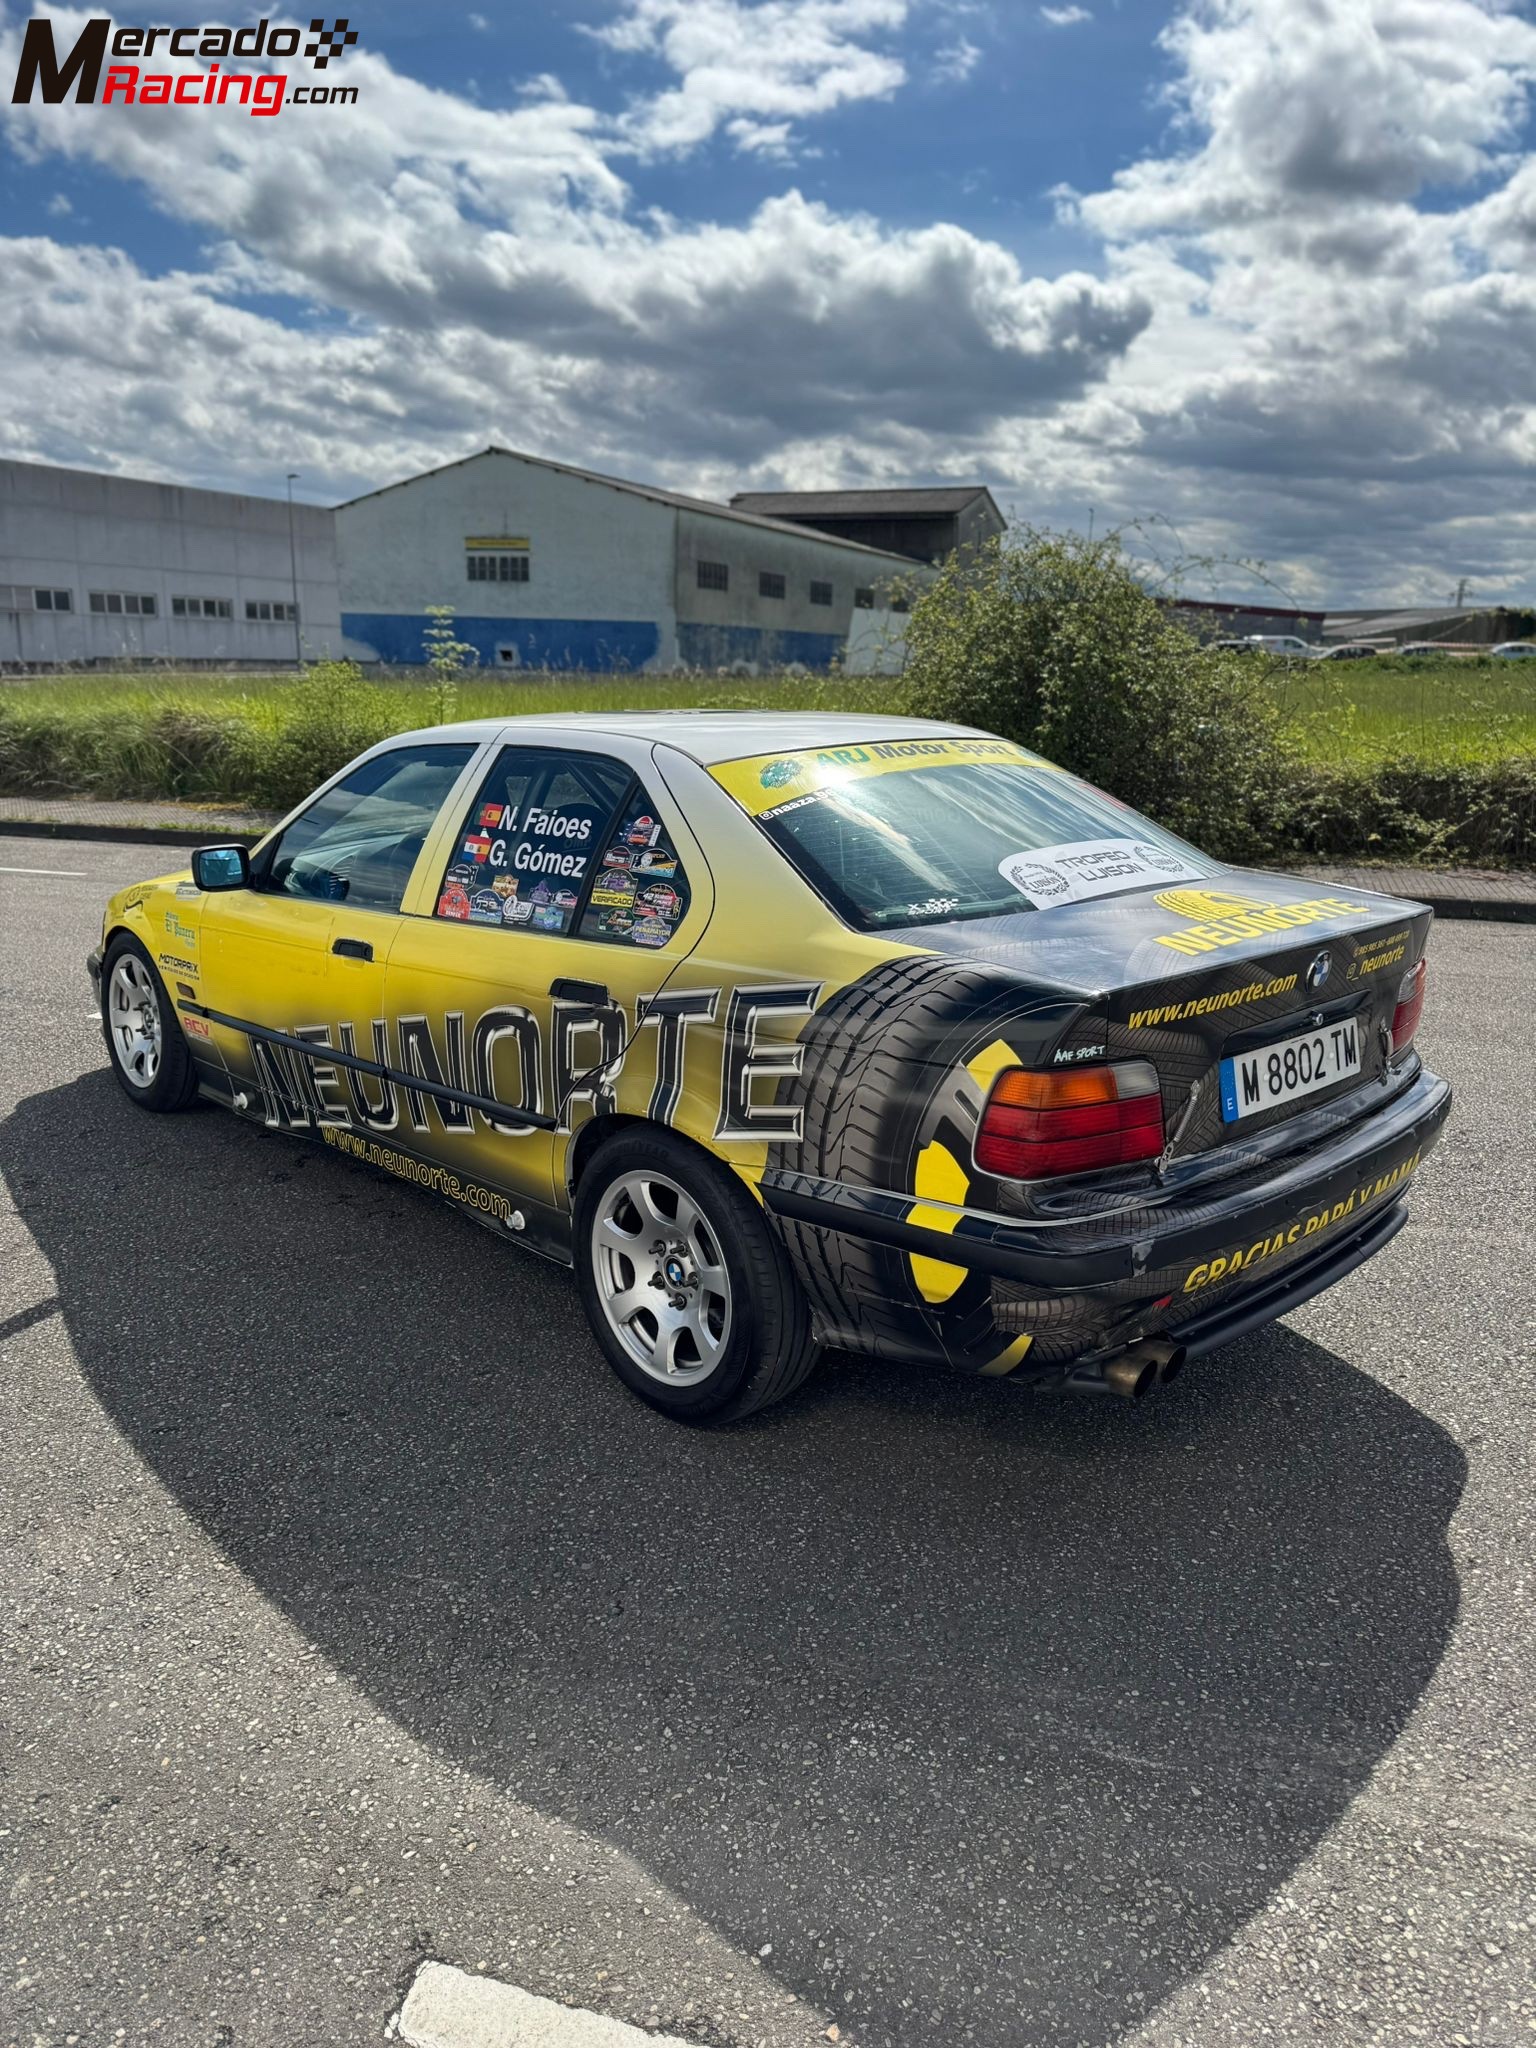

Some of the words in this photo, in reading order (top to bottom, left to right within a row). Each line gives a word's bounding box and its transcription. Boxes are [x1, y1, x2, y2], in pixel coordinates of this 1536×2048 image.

[816, 746, 871, 767] ARJ
[871, 742, 949, 760] Motor
[950, 741, 1015, 757] Sport
[498, 805, 517, 832] N.
[522, 807, 592, 840] Faioes
[489, 839, 508, 868] G.
[514, 841, 587, 878] Gómez
[1054, 850, 1131, 869] TROFEO
[1077, 862, 1147, 882] LUISON
[592, 895, 633, 906] VERIFICADO
[1153, 897, 1370, 956] NEUNORTE
[1128, 971, 1298, 1030] www.neunorte.com
[249, 981, 825, 1142] NEUNORTE
[1076, 1045, 1106, 1059] SPORT
[1242, 1059, 1260, 1106] M
[1267, 1038, 1326, 1095] 8802
[1330, 1025, 1357, 1071] TM
[1227, 1097, 1234, 1111] E
[321, 1124, 511, 1220] www.neunorte.com
[1182, 1224, 1301, 1293] GRACIAS
[1373, 1145, 1422, 1196] MAMÁ
